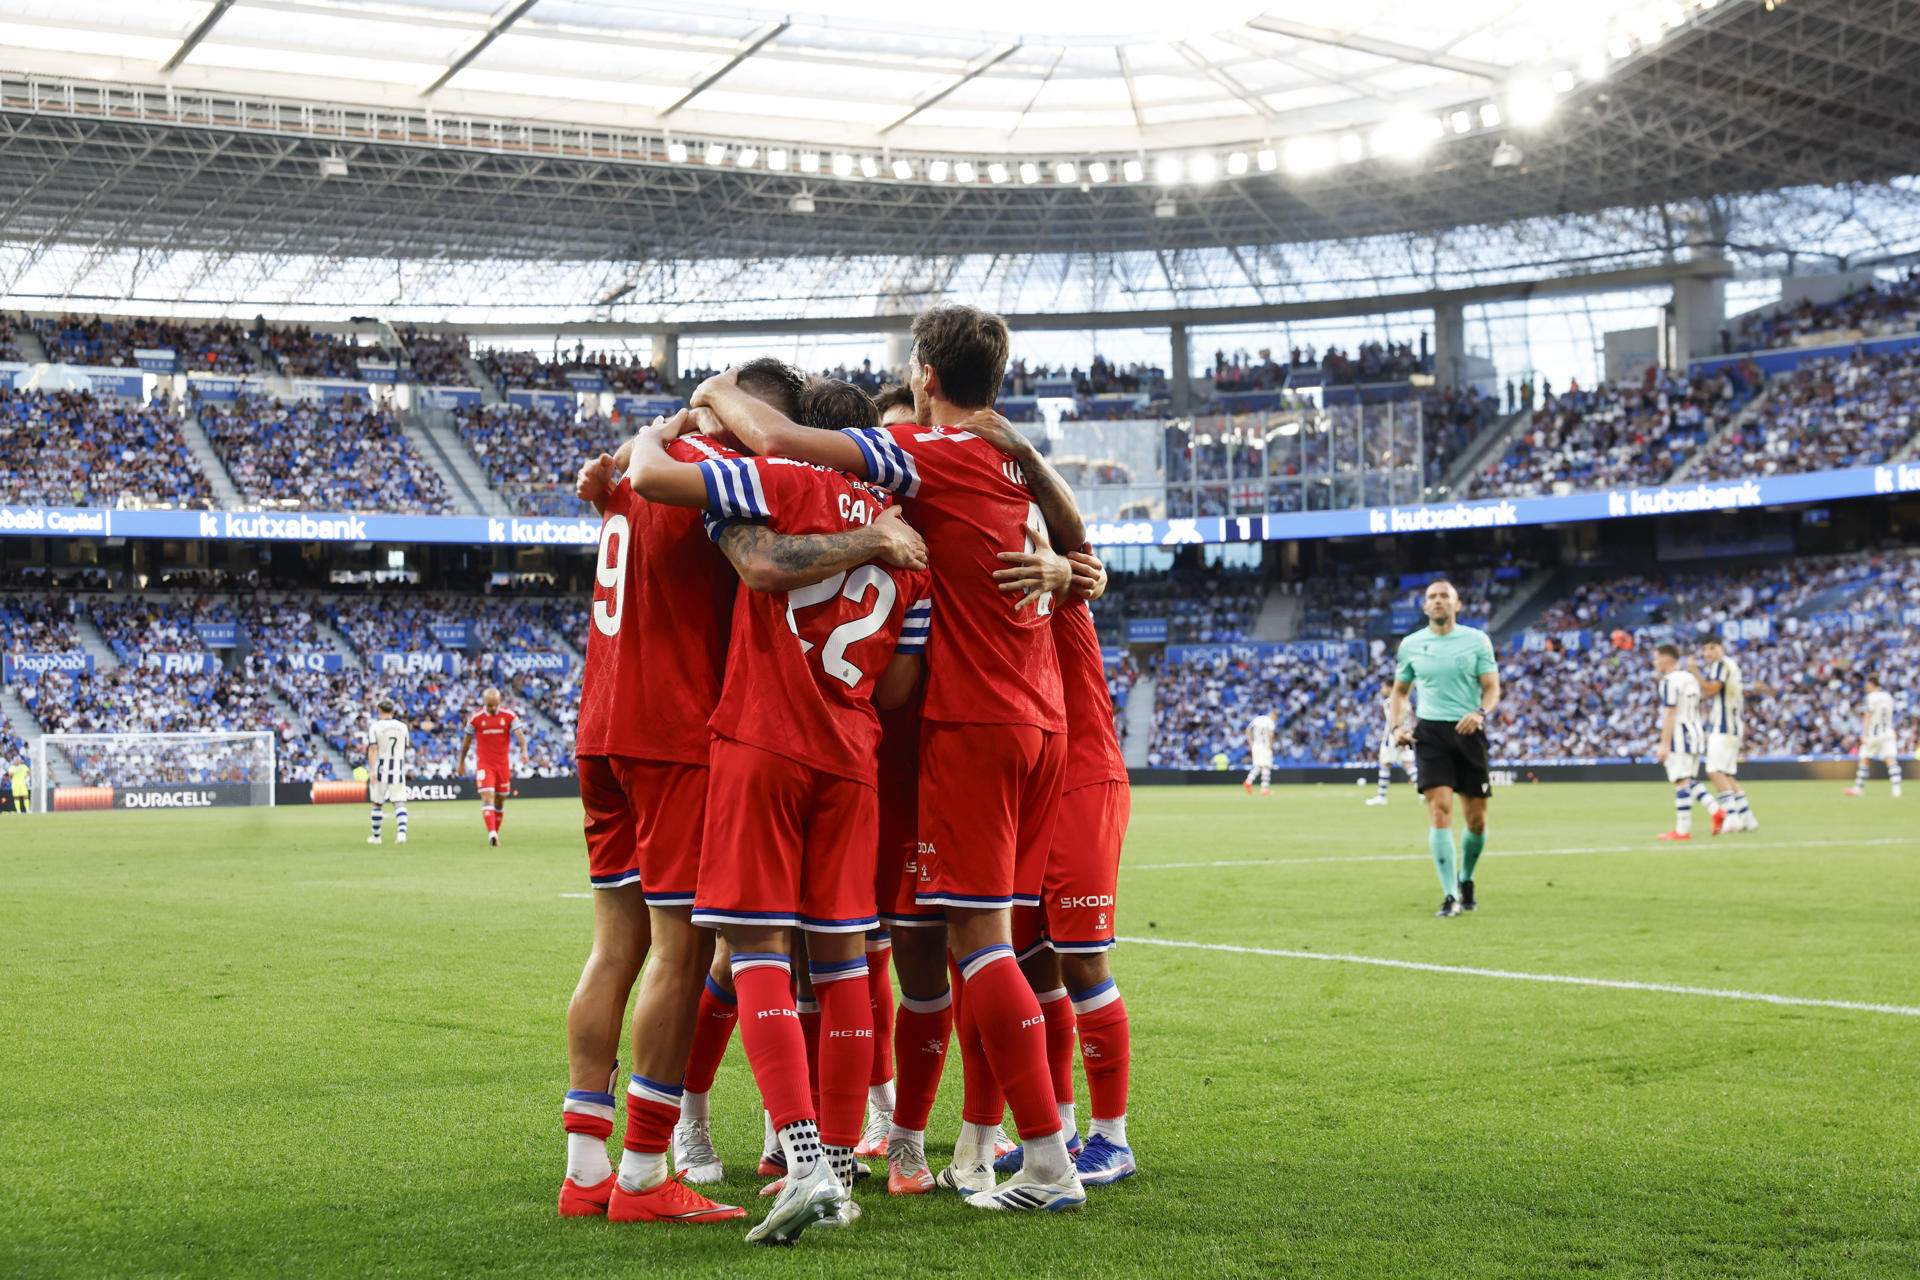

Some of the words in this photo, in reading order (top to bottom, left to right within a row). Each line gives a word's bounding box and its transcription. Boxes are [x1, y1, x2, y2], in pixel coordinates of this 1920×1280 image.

[1630, 480, 1761, 514] kutxabank
[48, 512, 103, 532] Capital
[225, 512, 367, 540] kutxabank
[1391, 500, 1518, 532] kutxabank
[593, 514, 630, 636] 9
[389, 736, 398, 757] 7
[125, 791, 212, 808] DURACELL
